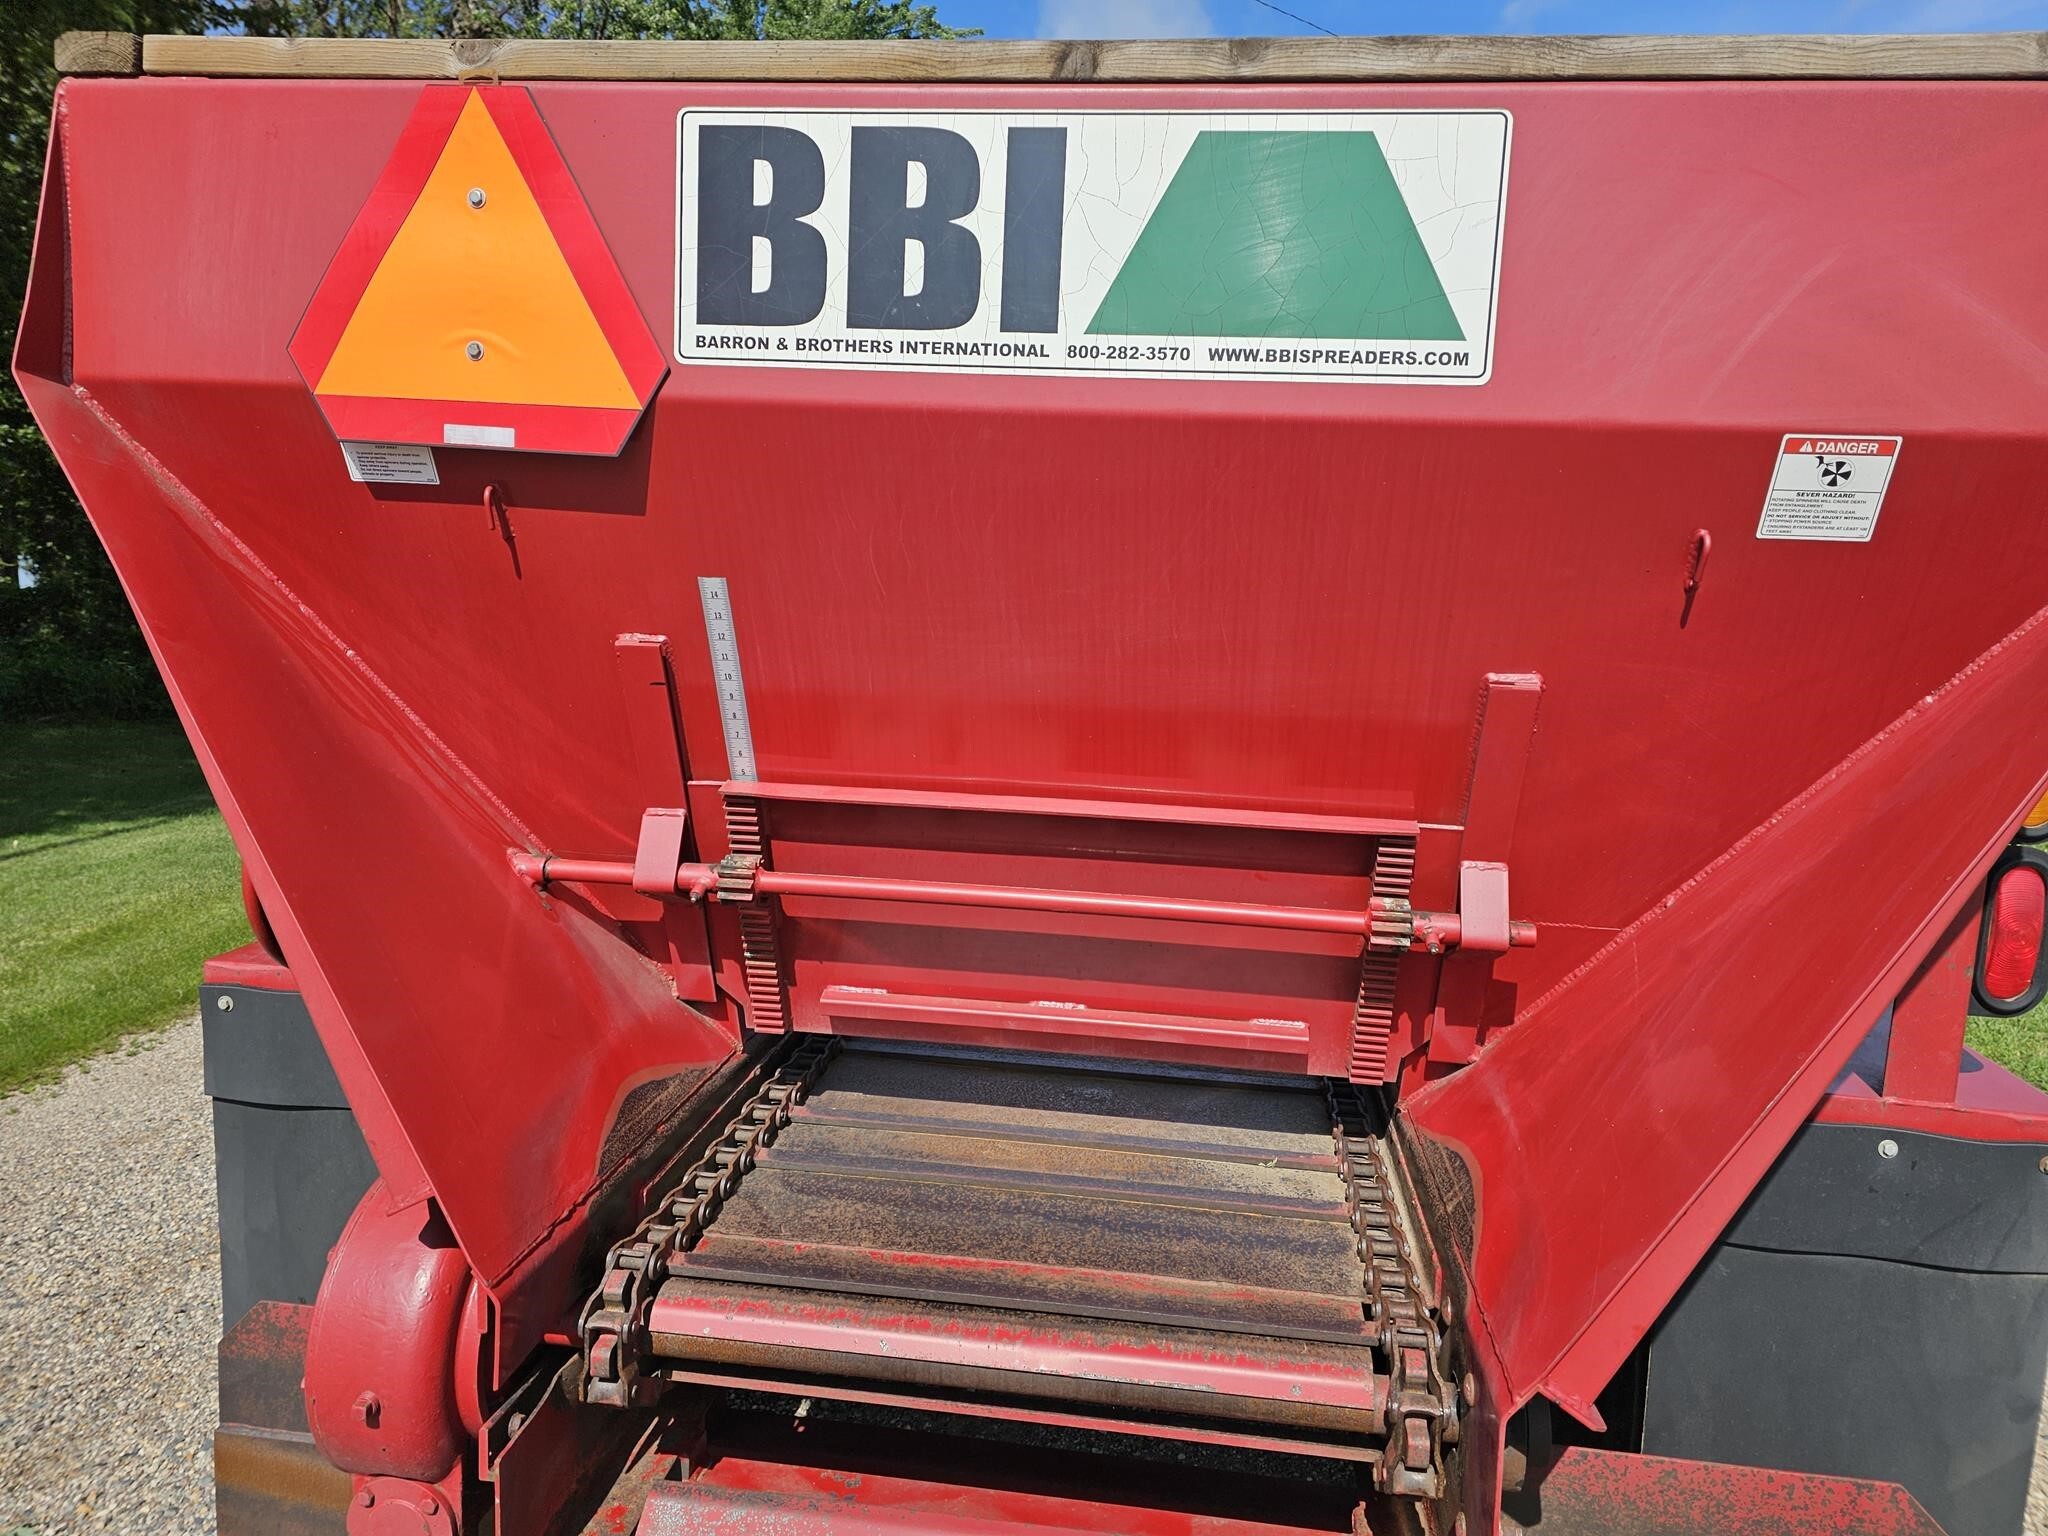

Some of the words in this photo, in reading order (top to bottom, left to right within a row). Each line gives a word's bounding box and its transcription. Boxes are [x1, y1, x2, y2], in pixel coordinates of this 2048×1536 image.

[696, 124, 1068, 334] BBI
[695, 335, 769, 350] BARRON
[776, 337, 789, 350] &
[796, 338, 894, 354] BROTHERS
[899, 340, 1050, 358] INTERNATIONAL
[1066, 344, 1191, 361] 800-282-3570
[1208, 347, 1470, 366] WWW.BBISPREADERS.COM
[1815, 442, 1879, 454] DANGER
